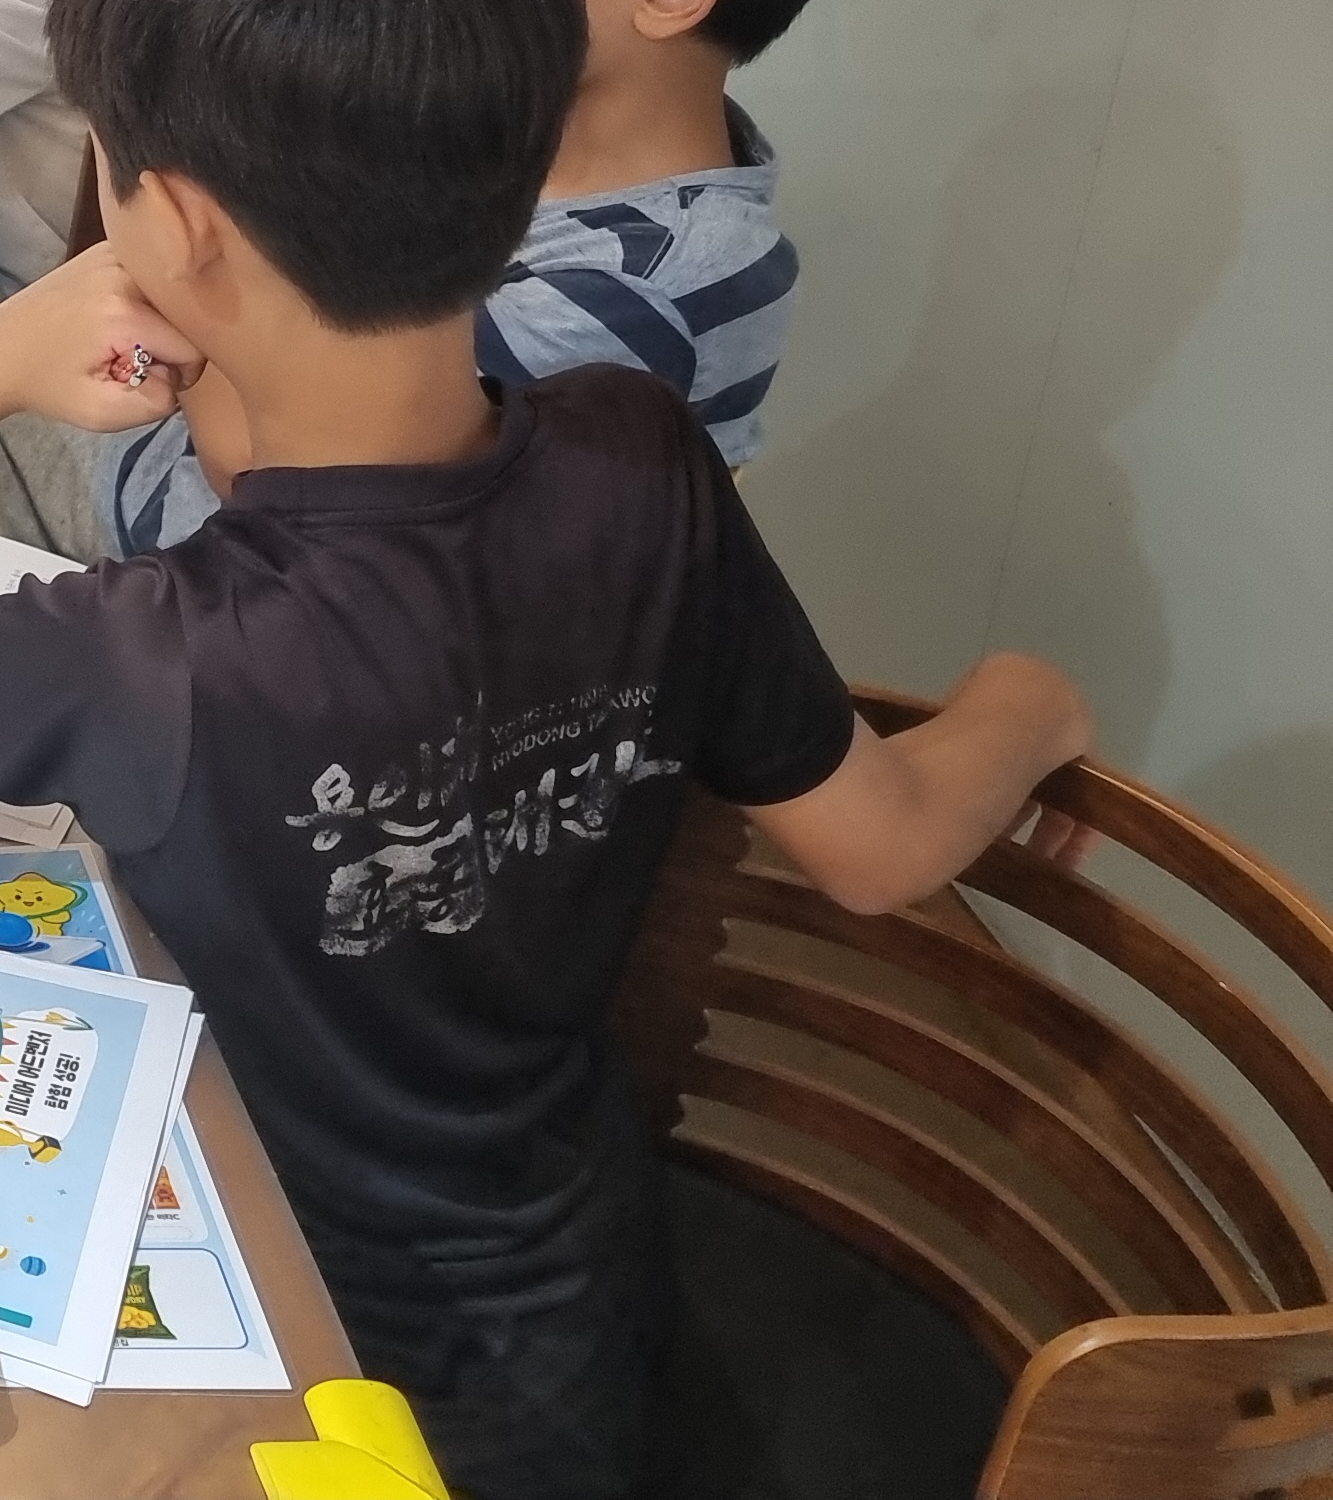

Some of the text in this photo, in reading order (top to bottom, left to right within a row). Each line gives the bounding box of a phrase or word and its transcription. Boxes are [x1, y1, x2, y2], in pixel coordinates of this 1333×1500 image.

[4, 1030, 52, 1117] 미디어 어드벤처
[44, 1053, 81, 1110] 탐험 성공!
